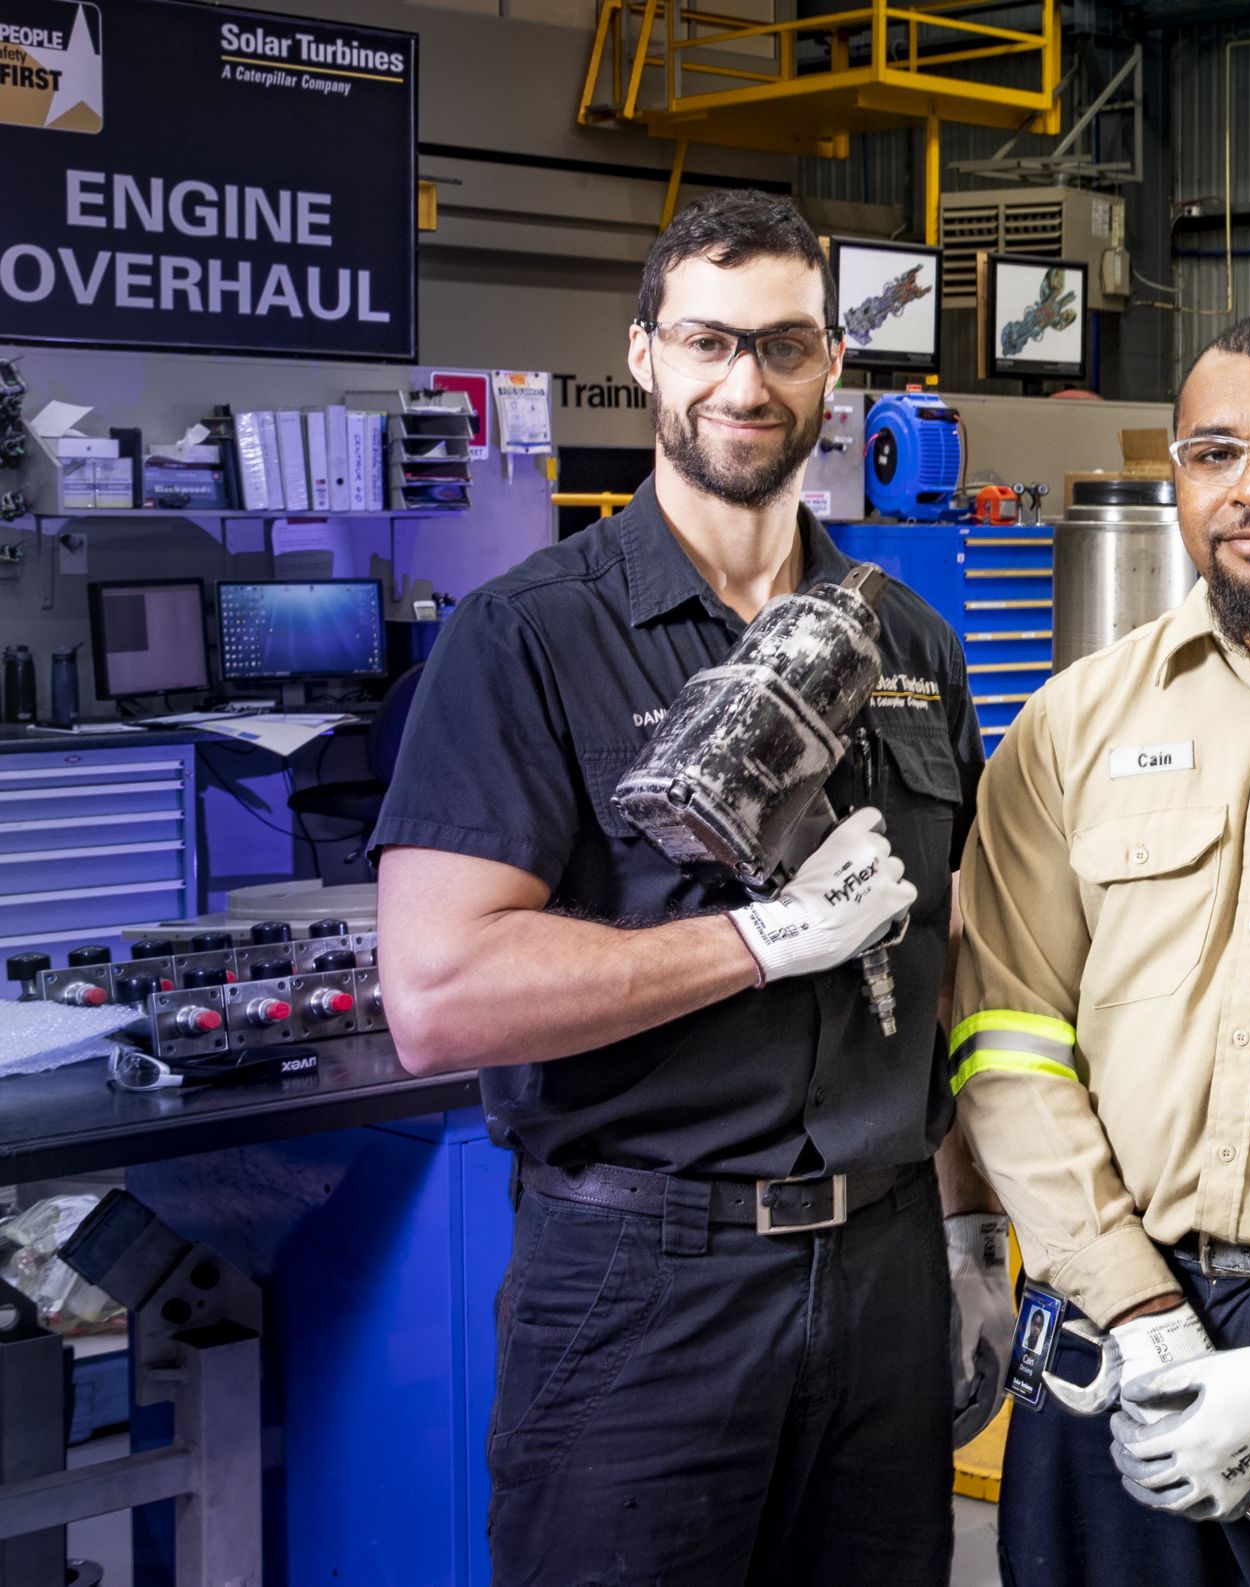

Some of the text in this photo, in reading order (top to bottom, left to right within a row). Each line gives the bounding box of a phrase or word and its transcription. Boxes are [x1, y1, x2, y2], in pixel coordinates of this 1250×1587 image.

[0, 23, 63, 49] PEOPLE
[221, 23, 404, 72] Solar Turbines
[0, 63, 62, 92] FIRST
[221, 65, 351, 96] A Caterpillar Company
[66, 169, 332, 246] ENGINE
[0, 244, 390, 322] OVERHAUL
[553, 374, 647, 409] Traini
[633, 708, 667, 727] DAN
[1138, 752, 1172, 768] Cain
[824, 862, 879, 906] HyFlex
[281, 1056, 317, 1072] uvex
